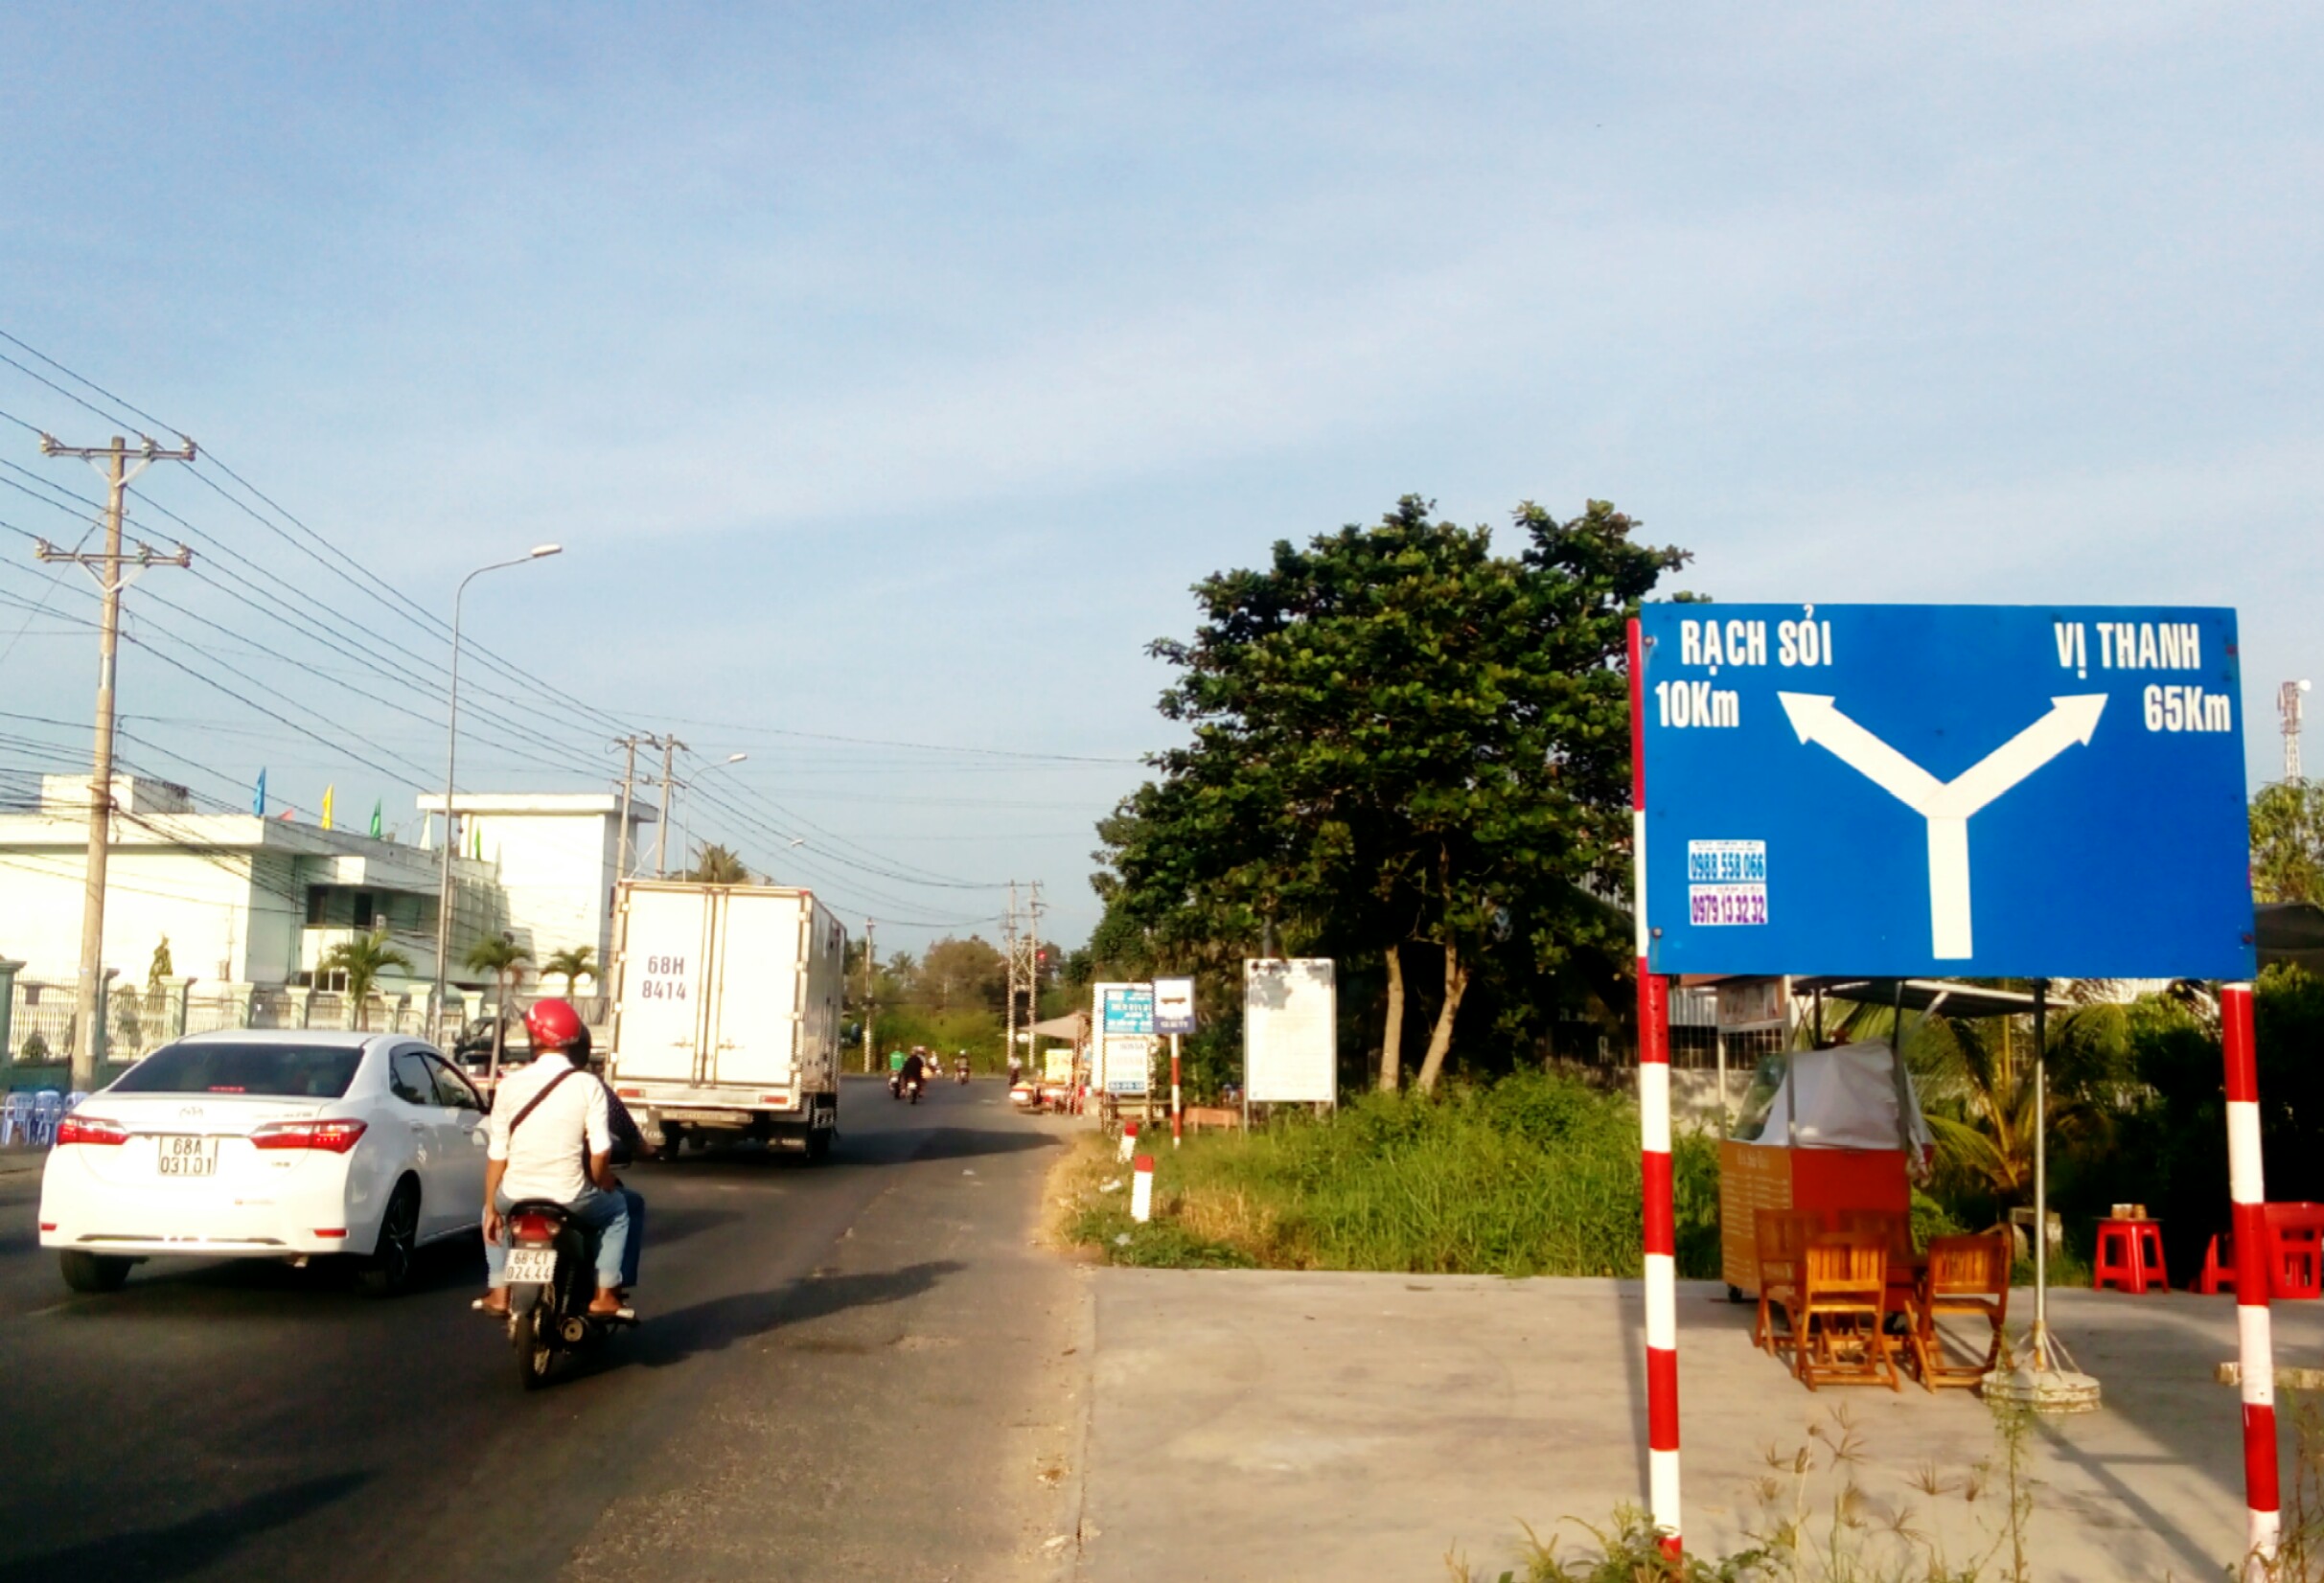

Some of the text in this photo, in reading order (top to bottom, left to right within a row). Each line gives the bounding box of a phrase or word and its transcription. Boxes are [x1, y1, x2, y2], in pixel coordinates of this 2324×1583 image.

[1681, 604, 1832, 677] RẠCH SỎI
[2054, 622, 2200, 679] VỊ THANH
[1654, 679, 1739, 728] 10Km
[2144, 683, 2232, 733] 65Km
[1691, 852, 1764, 879] 0988 558 066
[1691, 894, 1765, 923] 0979 13 32 32
[648, 955, 684, 975] 68H
[642, 979, 686, 1000] 8414
[173, 1137, 202, 1156] 68A
